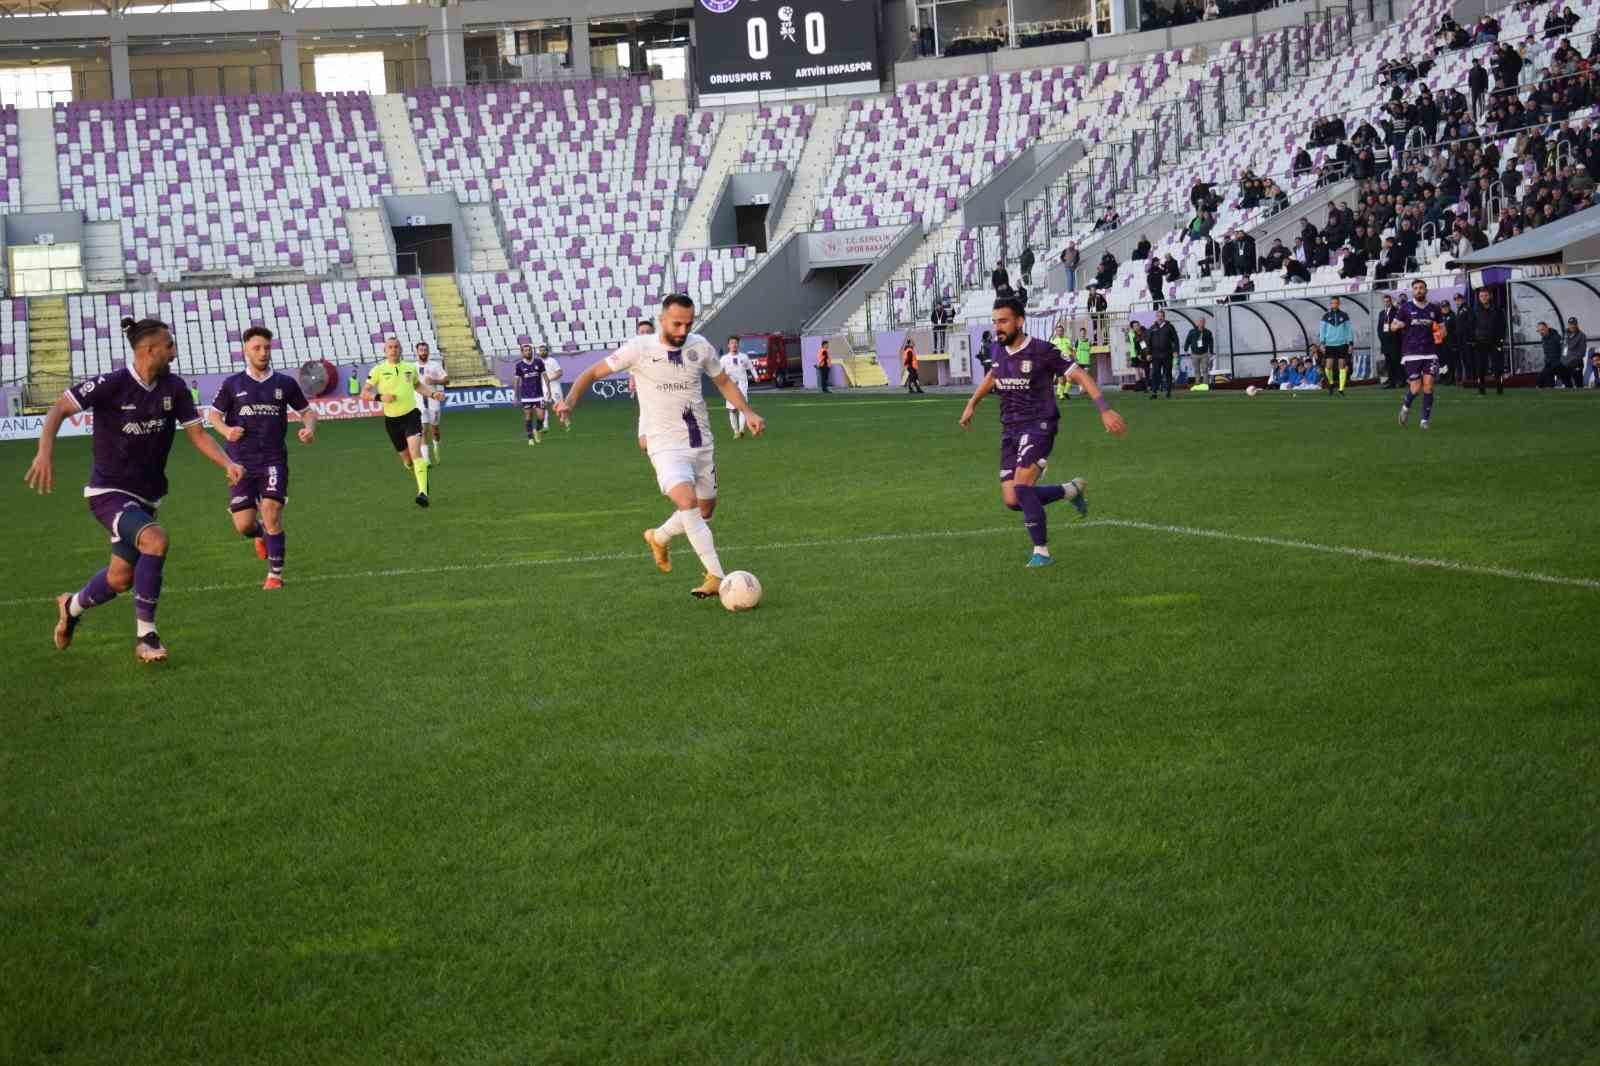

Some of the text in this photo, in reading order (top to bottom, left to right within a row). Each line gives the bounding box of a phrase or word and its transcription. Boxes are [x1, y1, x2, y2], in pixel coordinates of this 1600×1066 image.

[747, 17, 768, 60] 0
[805, 12, 826, 55] 0
[710, 71, 771, 84] ORDUSPOR FK
[827, 62, 872, 74] HOPASPOR
